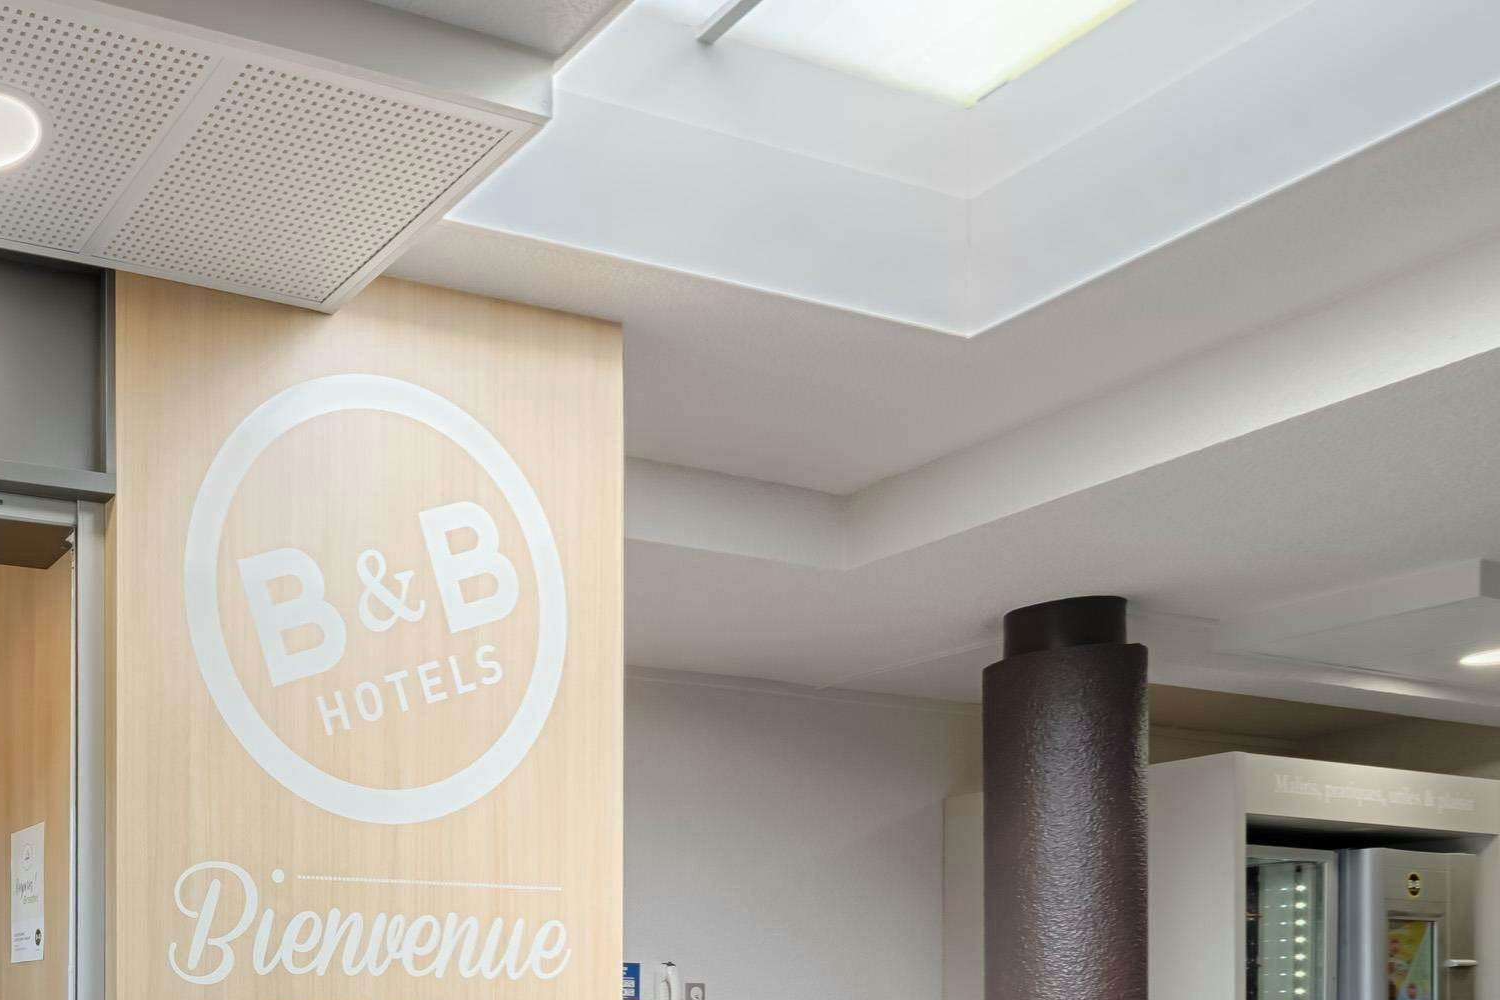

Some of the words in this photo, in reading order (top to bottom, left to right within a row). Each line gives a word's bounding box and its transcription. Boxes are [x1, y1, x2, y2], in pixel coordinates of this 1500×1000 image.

[236, 501, 520, 687] B&B
[316, 645, 504, 736] HOTELS
[168, 861, 571, 985] Bienvenue
